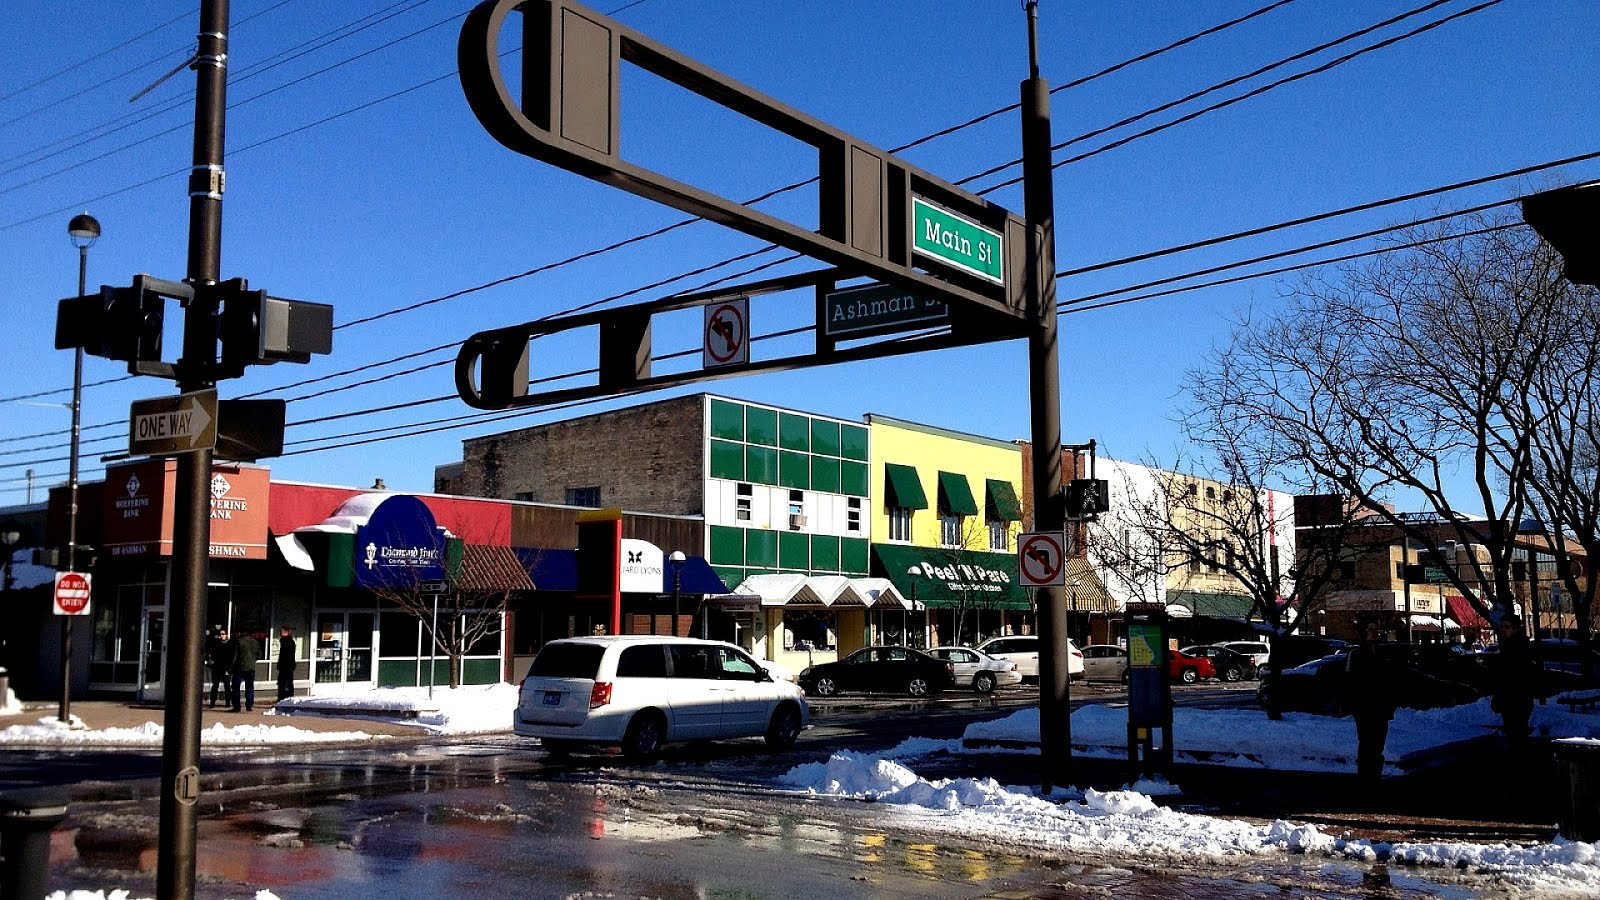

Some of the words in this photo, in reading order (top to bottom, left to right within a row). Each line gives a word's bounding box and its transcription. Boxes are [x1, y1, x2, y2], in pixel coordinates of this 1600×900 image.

[925, 217, 972, 257] Main
[978, 240, 992, 265] St
[832, 294, 916, 322] Ashman
[139, 415, 166, 438] ONE
[169, 411, 193, 436] WAY
[209, 500, 248, 511] VERINE
[209, 510, 232, 520] ANK
[208, 546, 247, 556] SHMAN
[640, 566, 661, 575] LYONS
[920, 562, 959, 580] Peel
[974, 565, 1011, 583] Pare
[60, 580, 71, 589] DO
[72, 580, 86, 589] NOT
[61, 598, 83, 607] ENTER
